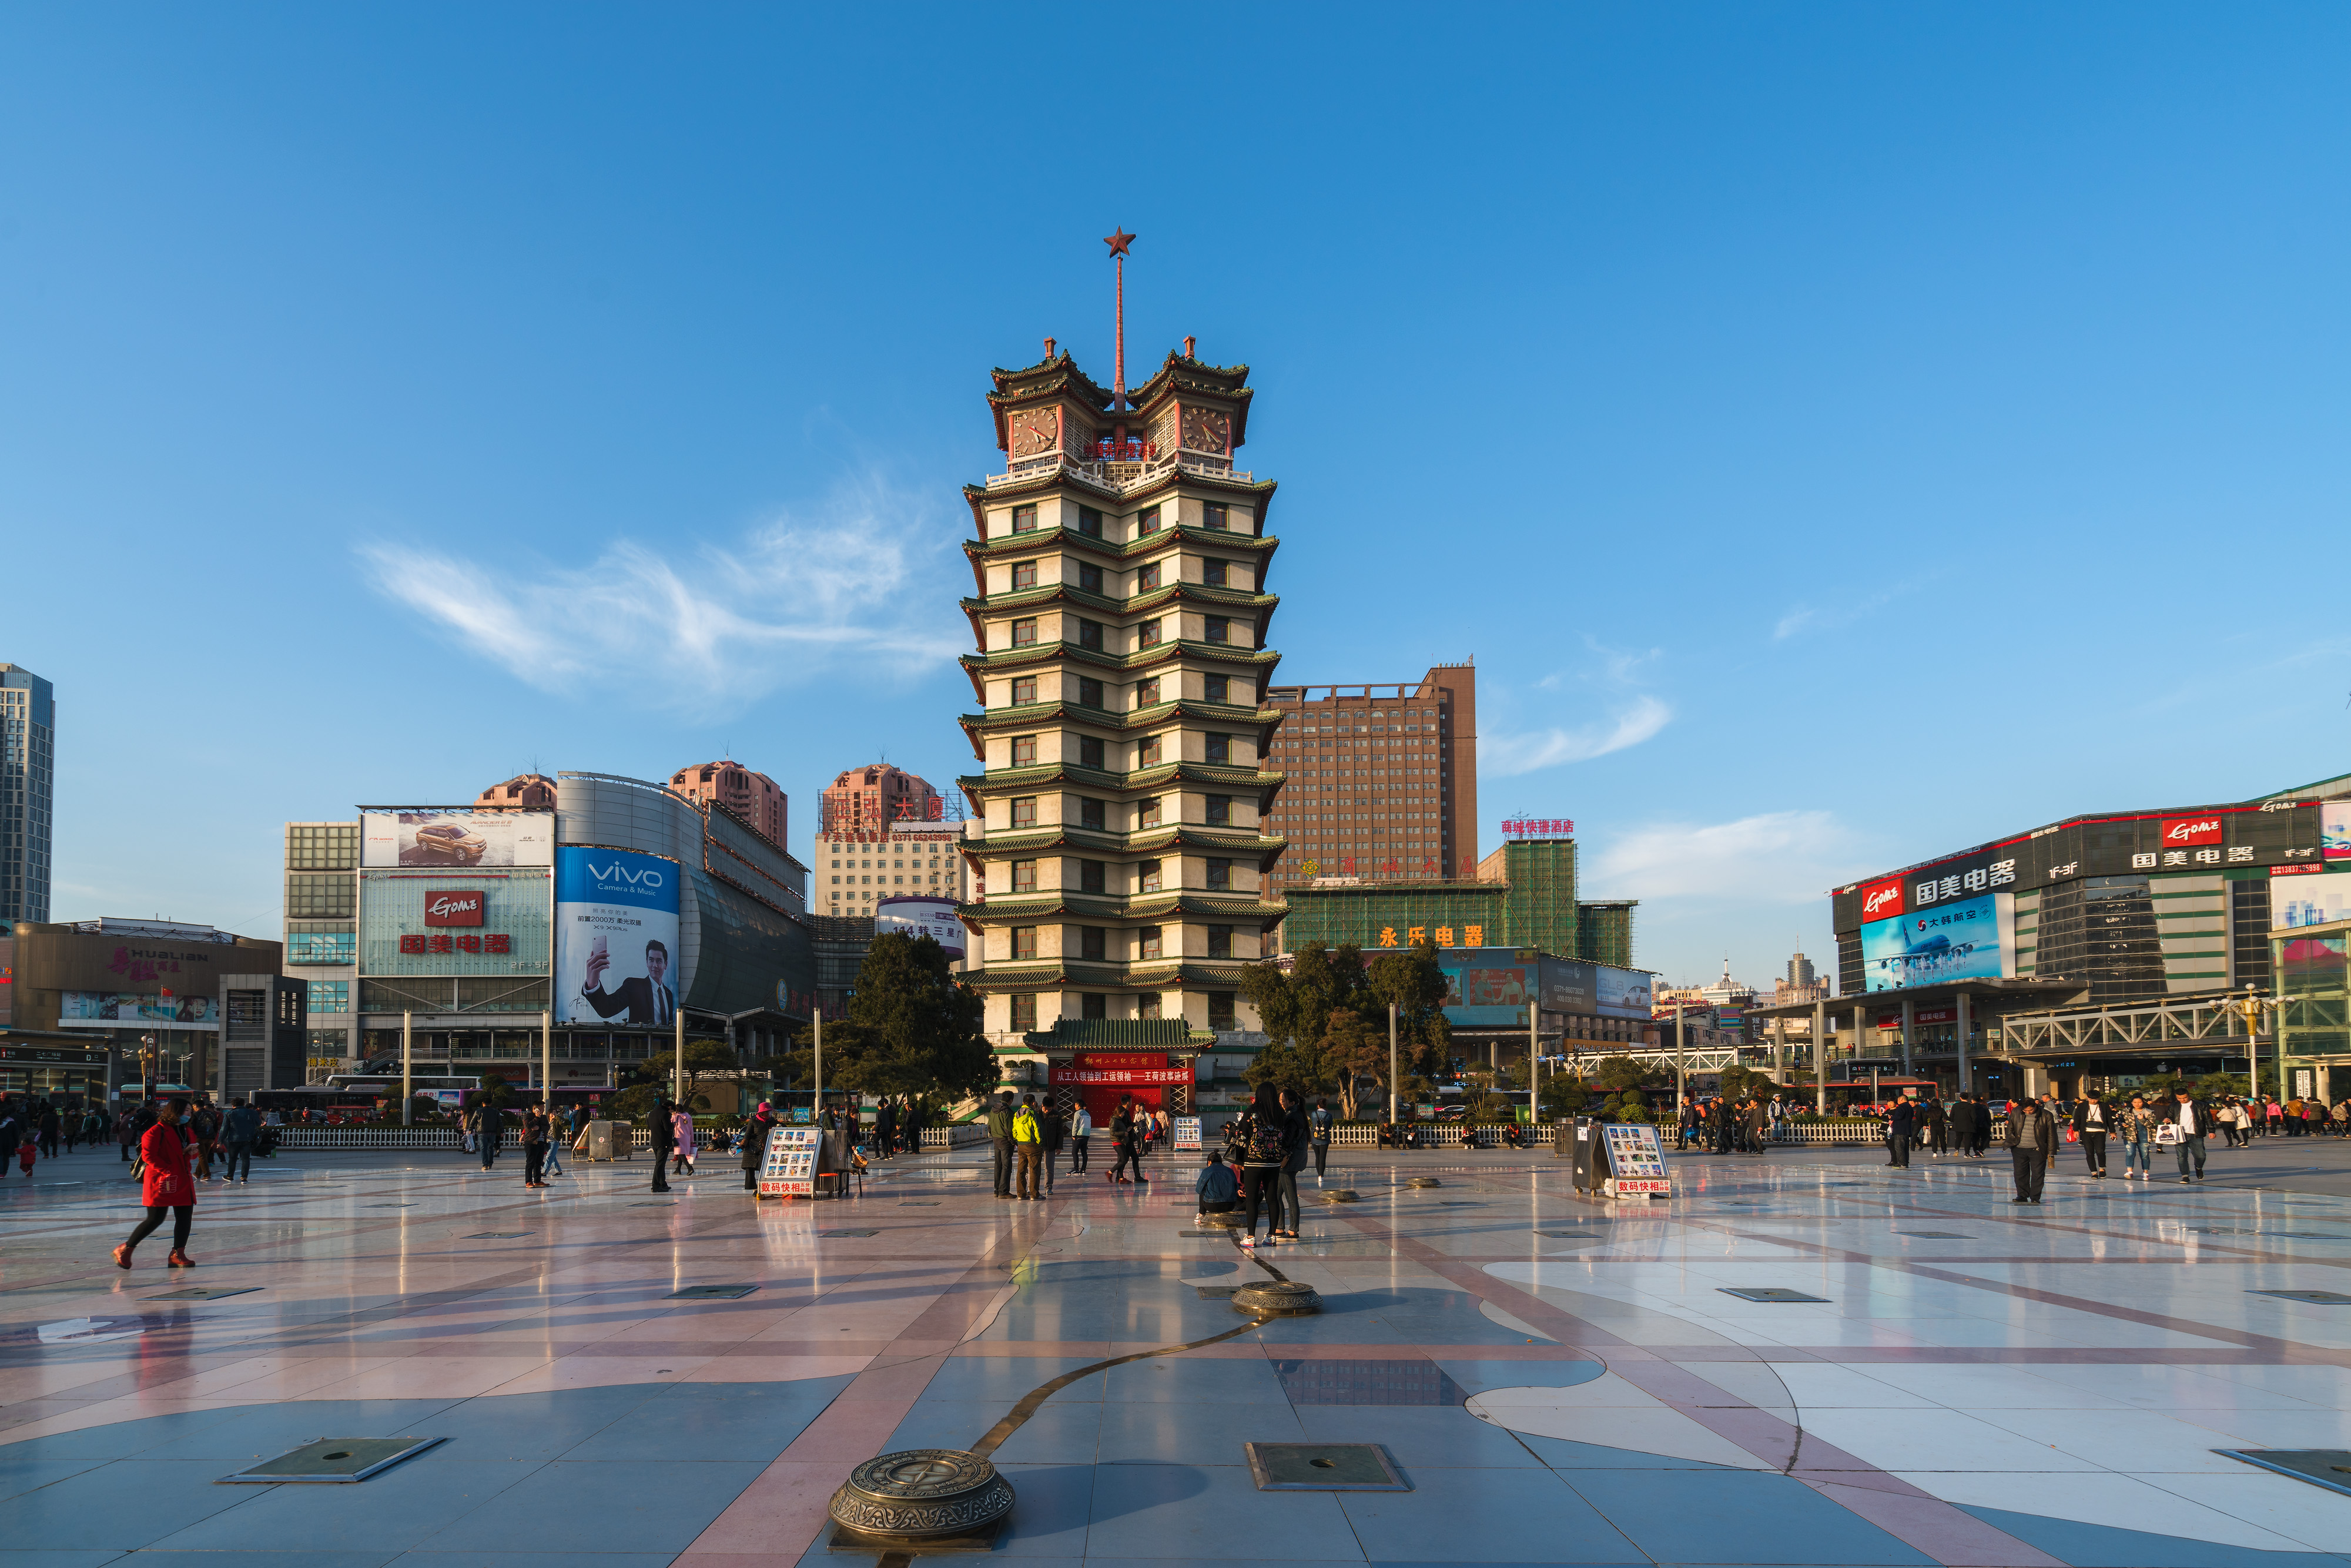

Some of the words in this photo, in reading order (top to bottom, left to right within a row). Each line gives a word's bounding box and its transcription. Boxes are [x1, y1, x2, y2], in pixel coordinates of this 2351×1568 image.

[1084, 442, 1157, 457] 中国共产党万岁
[1501, 820, 1574, 833] 商城快捷酒店
[2132, 846, 2254, 868] 国美电器
[588, 860, 663, 887] vivo
[2281, 864, 2320, 873] 13837195998
[1916, 858, 2015, 906] 国美电器
[598, 883, 628, 892] Camera
[637, 887, 656, 896] Music
[592, 908, 628, 916] 照亮你的美
[577, 916, 615, 924] 前置2000万
[617, 917, 641, 926] 柔光双摄
[1930, 910, 1977, 928] 大韩航空
[1379, 925, 1483, 948] 永乐电器
[400, 934, 510, 954] 国美电器
[1554, 984, 1585, 995] 0371-86073028
[1598, 977, 1624, 991] GL8
[1920, 1011, 1946, 1021] 国美电器
[1057, 1071, 1188, 1081] 从工人领袖到工运领袖——王荷波事迹展
[761, 1182, 800, 1192] 数码快相
[1619, 1181, 1659, 1192] 数码快相
